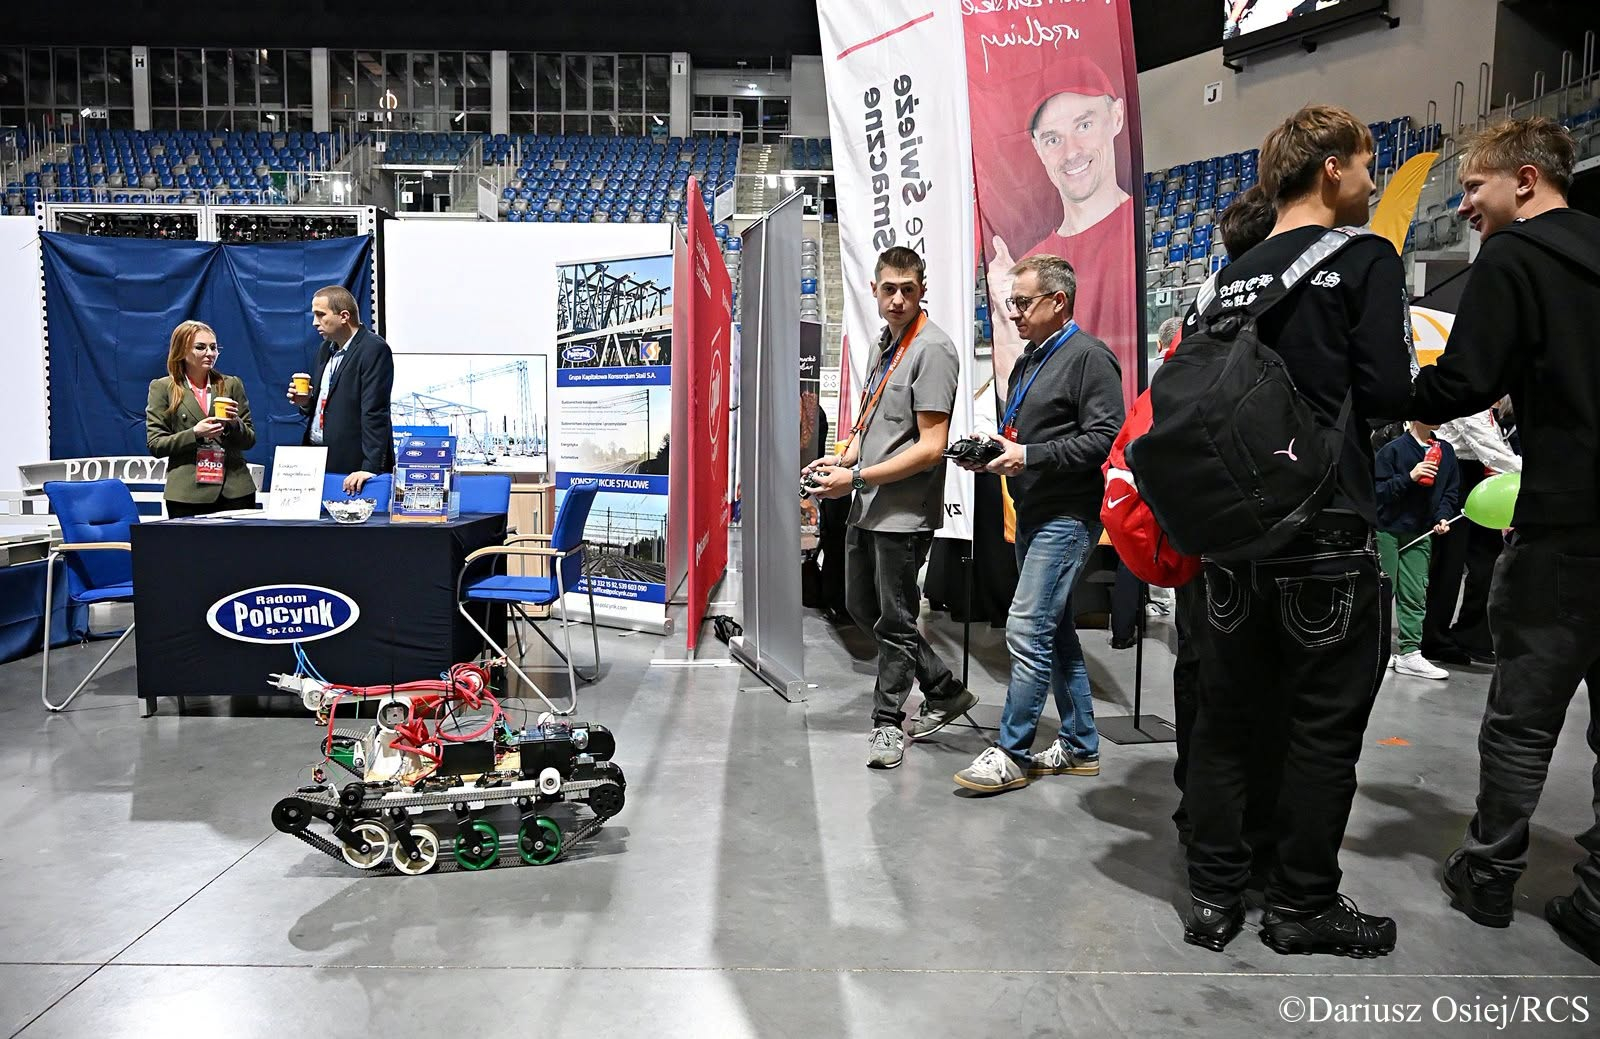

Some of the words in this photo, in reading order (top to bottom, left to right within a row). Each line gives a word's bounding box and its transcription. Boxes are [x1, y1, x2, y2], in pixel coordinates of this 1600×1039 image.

[135, 58, 145, 68] H
[1207, 88, 1217, 103] J
[1160, 292, 1168, 304] J
[198, 459, 223, 470] expo
[616, 479, 649, 489] STALOWE
[256, 594, 307, 605] Radom
[233, 598, 334, 634] Polcynk
